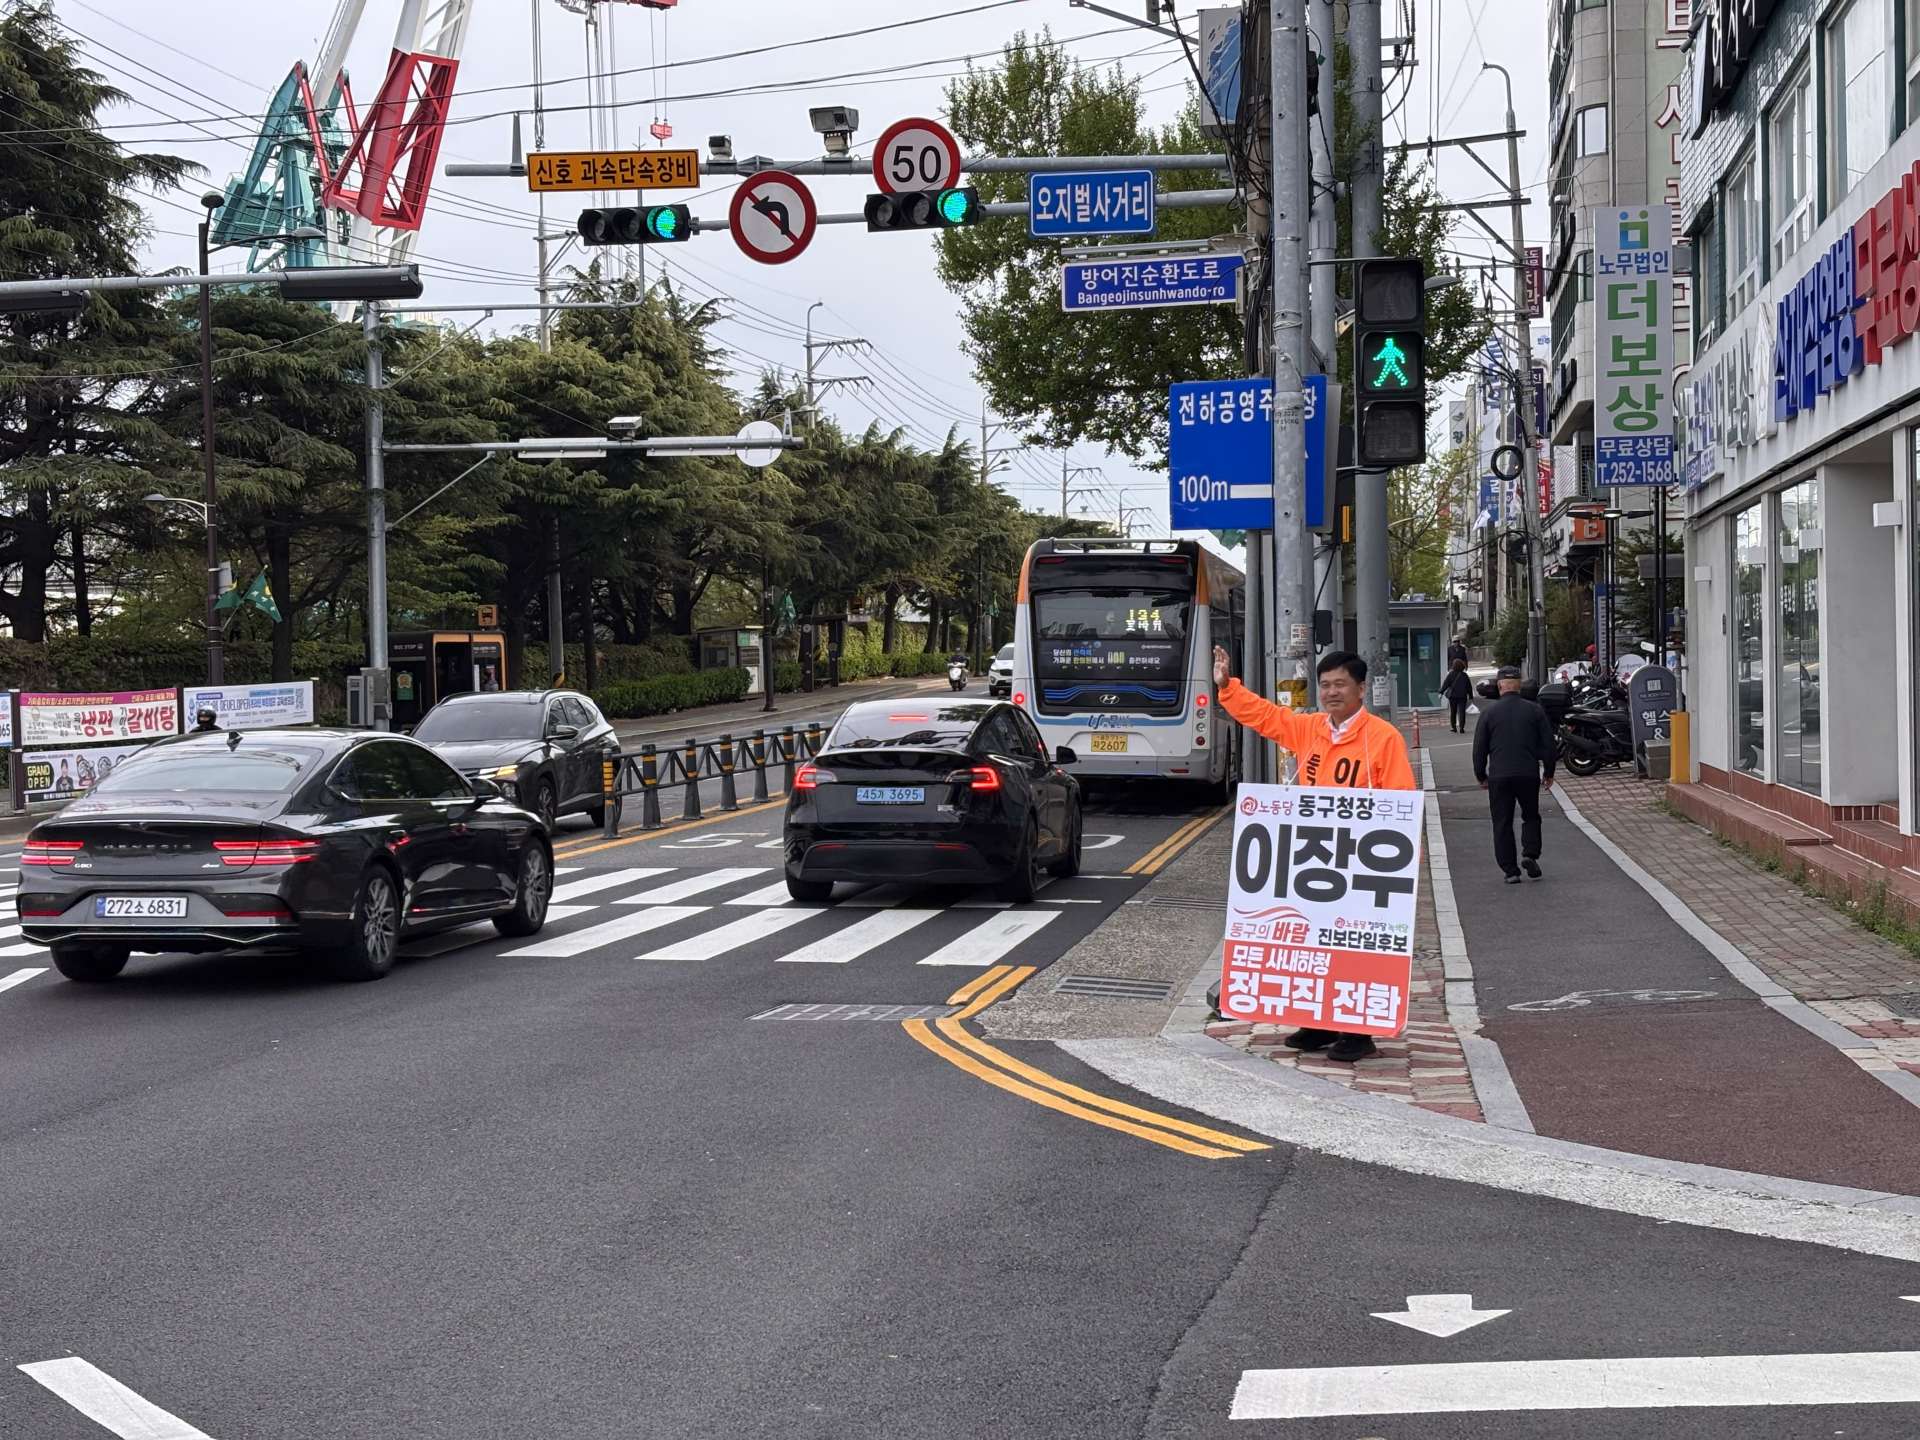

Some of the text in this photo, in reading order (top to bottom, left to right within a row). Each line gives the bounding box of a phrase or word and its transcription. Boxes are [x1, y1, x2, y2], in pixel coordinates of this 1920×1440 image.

[535, 156, 692, 186] 신호 과속단속장비
[891, 145, 942, 184] 50
[1036, 180, 1149, 224] 오지벌사거리
[1598, 250, 1669, 275] 노무법인
[1080, 261, 1221, 291] 방어진순환도로
[1077, 284, 1225, 305] Bangeojinsunhwando-ro
[1605, 278, 1665, 433] 더보상
[1178, 385, 1318, 427] 전하공영주장
[1599, 437, 1671, 458] 무료상담
[1597, 460, 1672, 485] T.252-1568
[1178, 475, 1228, 503] 100m
[1129, 608, 1160, 621] 134
[1642, 709, 1671, 726] 헬스
[27, 764, 50, 777] GRAND
[27, 776, 51, 789] OPEN
[889, 789, 919, 800] 3695
[1257, 794, 1415, 822] 노동당 동구청장 후보
[1235, 822, 1415, 909] 이장우
[106, 898, 183, 915] 272소 6831
[1229, 920, 1310, 944] 동구의 바람
[1318, 928, 1408, 953] 진보단일후보
[1231, 945, 1332, 975] 모든 사내하청
[1227, 970, 1401, 1029] 정규직 전환
